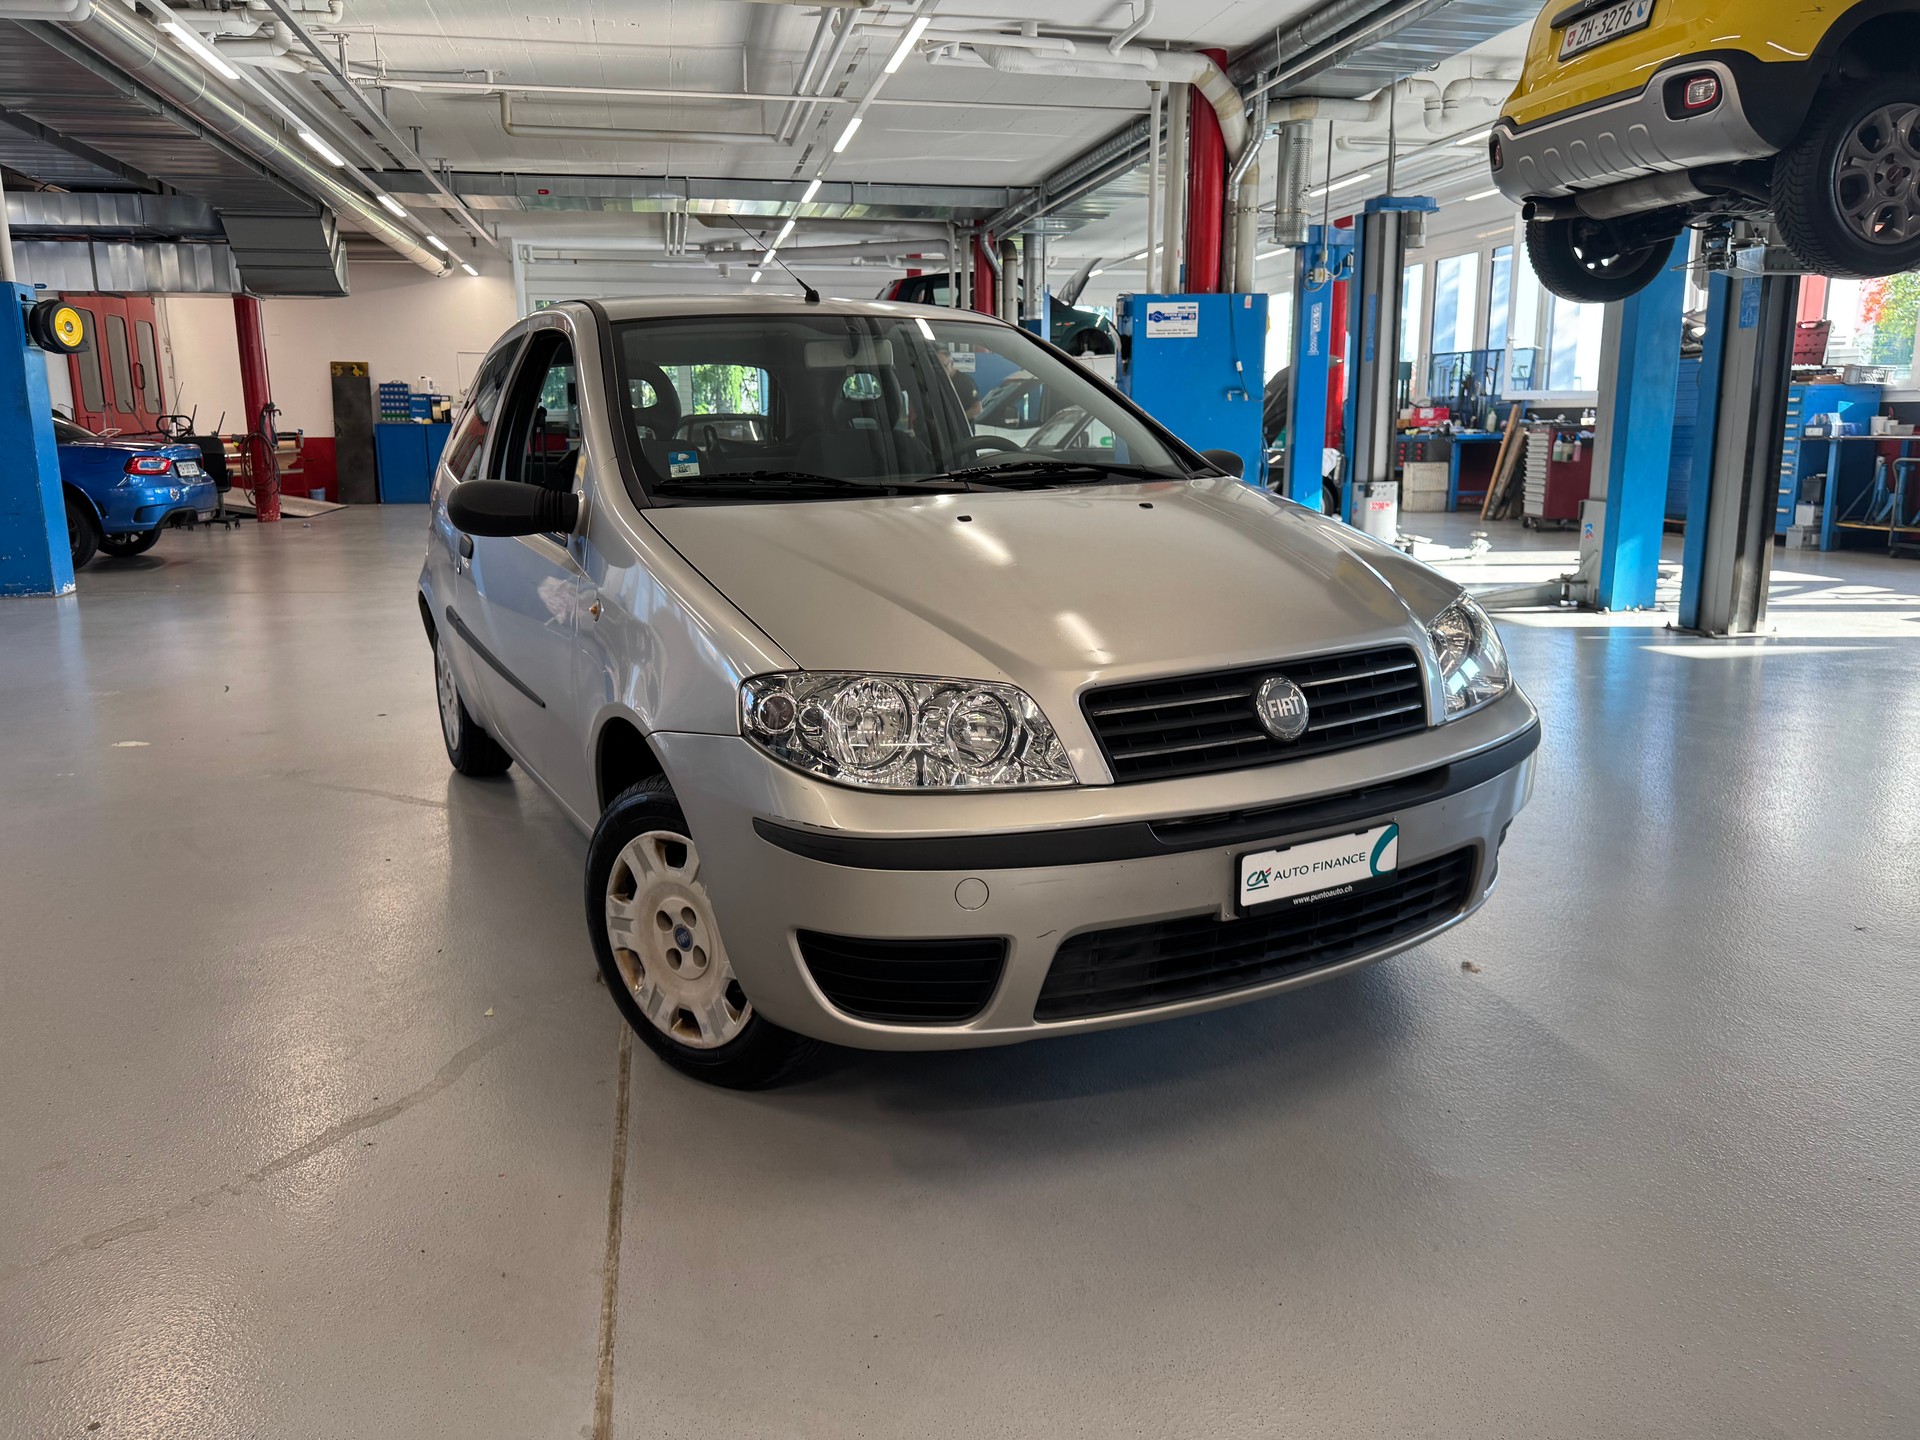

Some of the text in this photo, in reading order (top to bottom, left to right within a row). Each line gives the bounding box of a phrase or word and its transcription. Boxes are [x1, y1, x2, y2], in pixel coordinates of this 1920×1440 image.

[1267, 696, 1301, 719] FIAT
[1273, 864, 1310, 881] AUTO
[1312, 851, 1367, 873] FINANCE
[1292, 884, 1353, 905] www.puntoauto.ch
